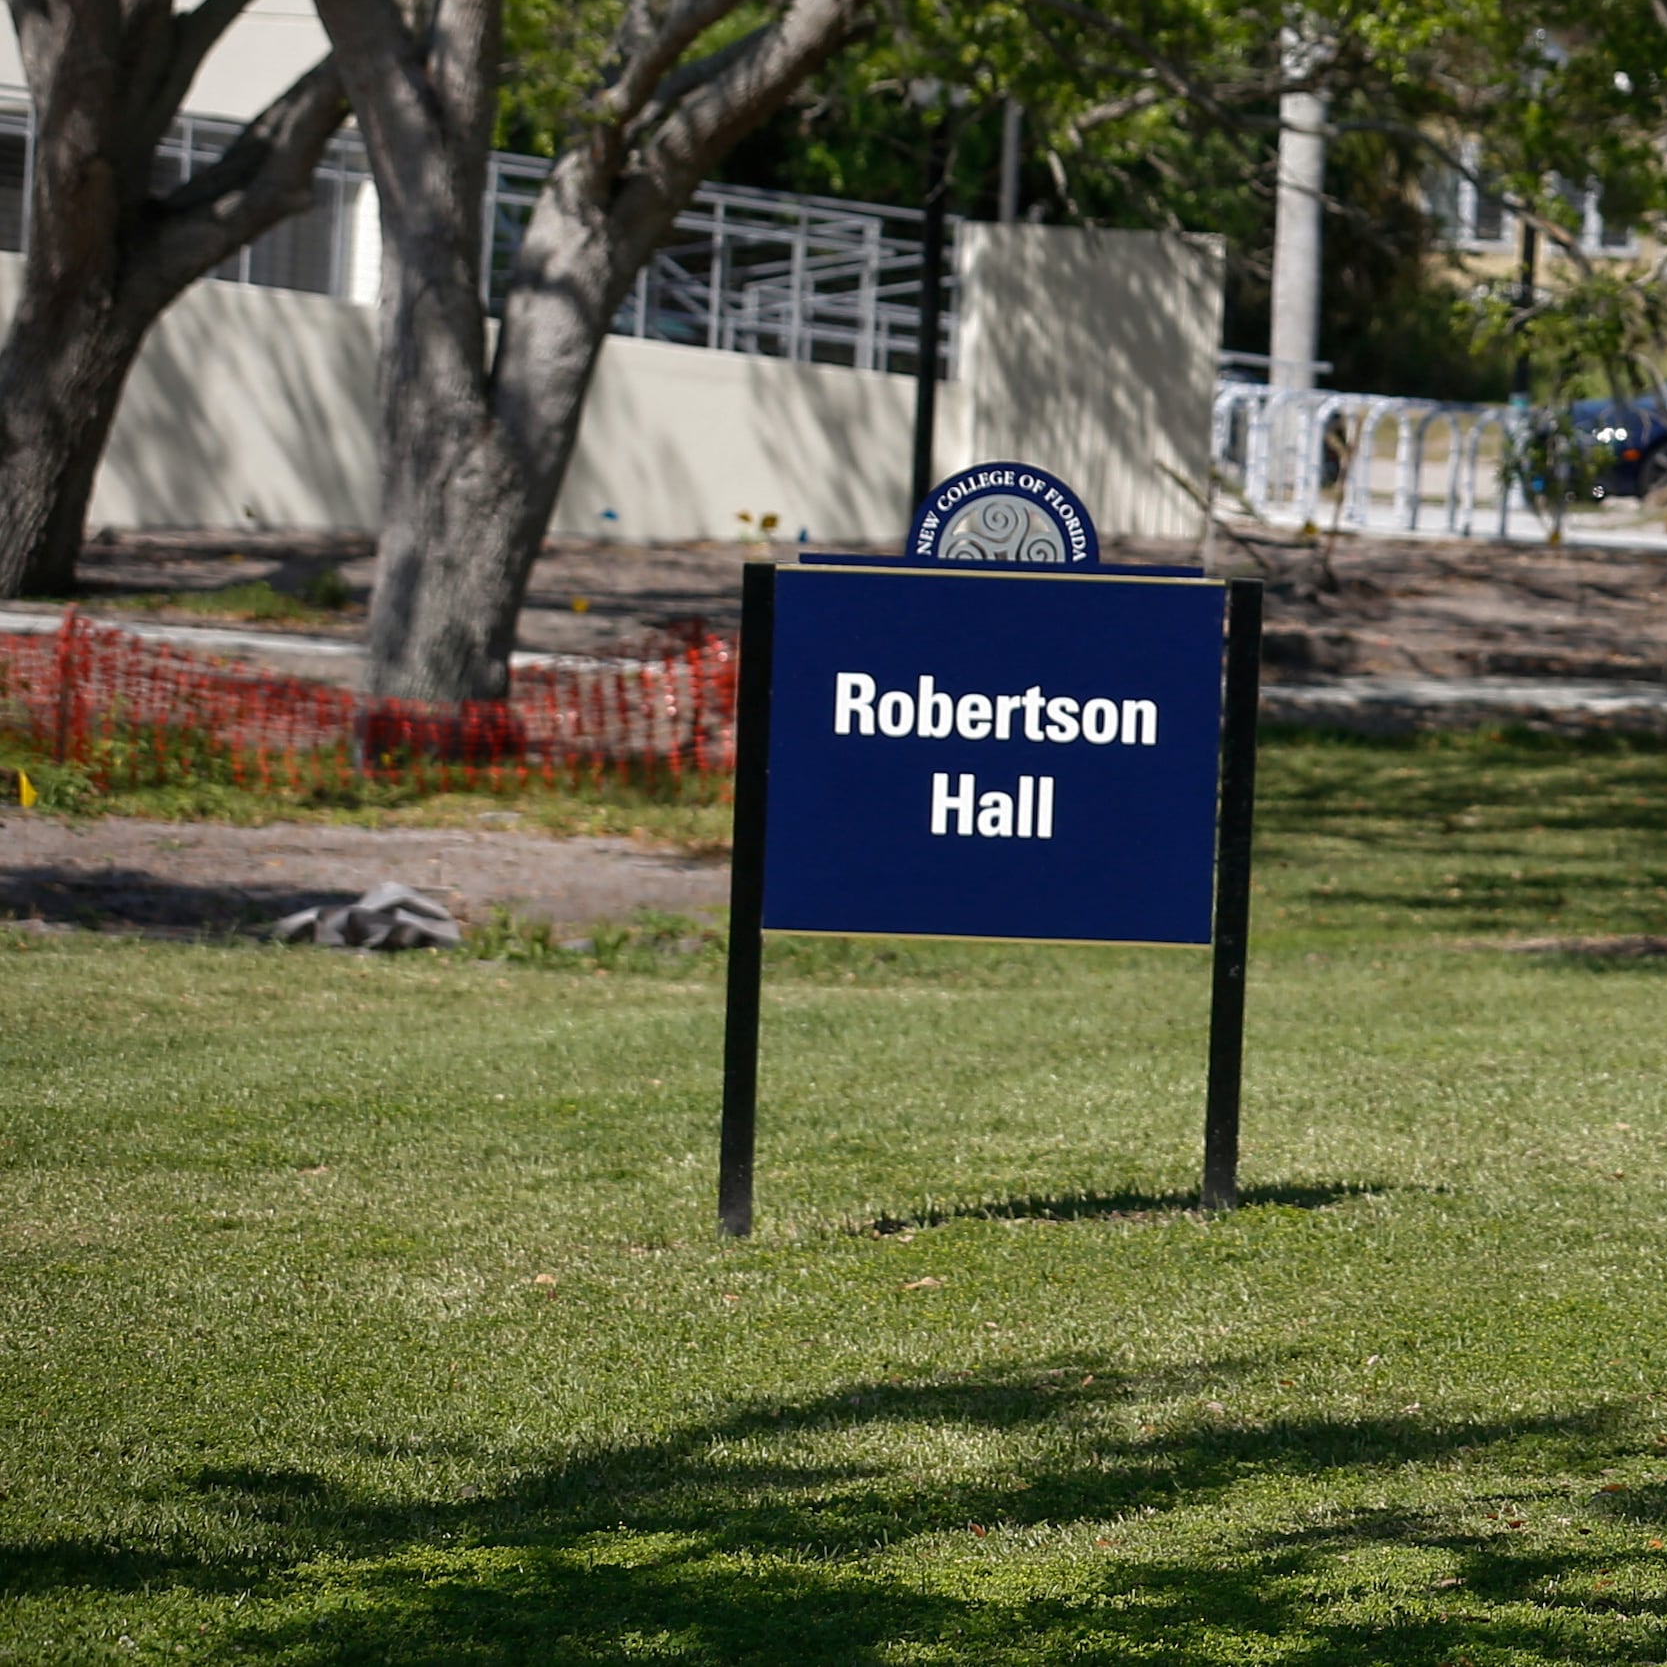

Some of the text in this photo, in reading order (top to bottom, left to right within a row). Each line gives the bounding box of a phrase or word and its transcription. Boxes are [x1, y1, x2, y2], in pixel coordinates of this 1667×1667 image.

[916, 470, 1088, 562] NEW COLLEGE OF FLORIDA
[834, 672, 1157, 745] Robertson
[931, 772, 1054, 839] Hall
